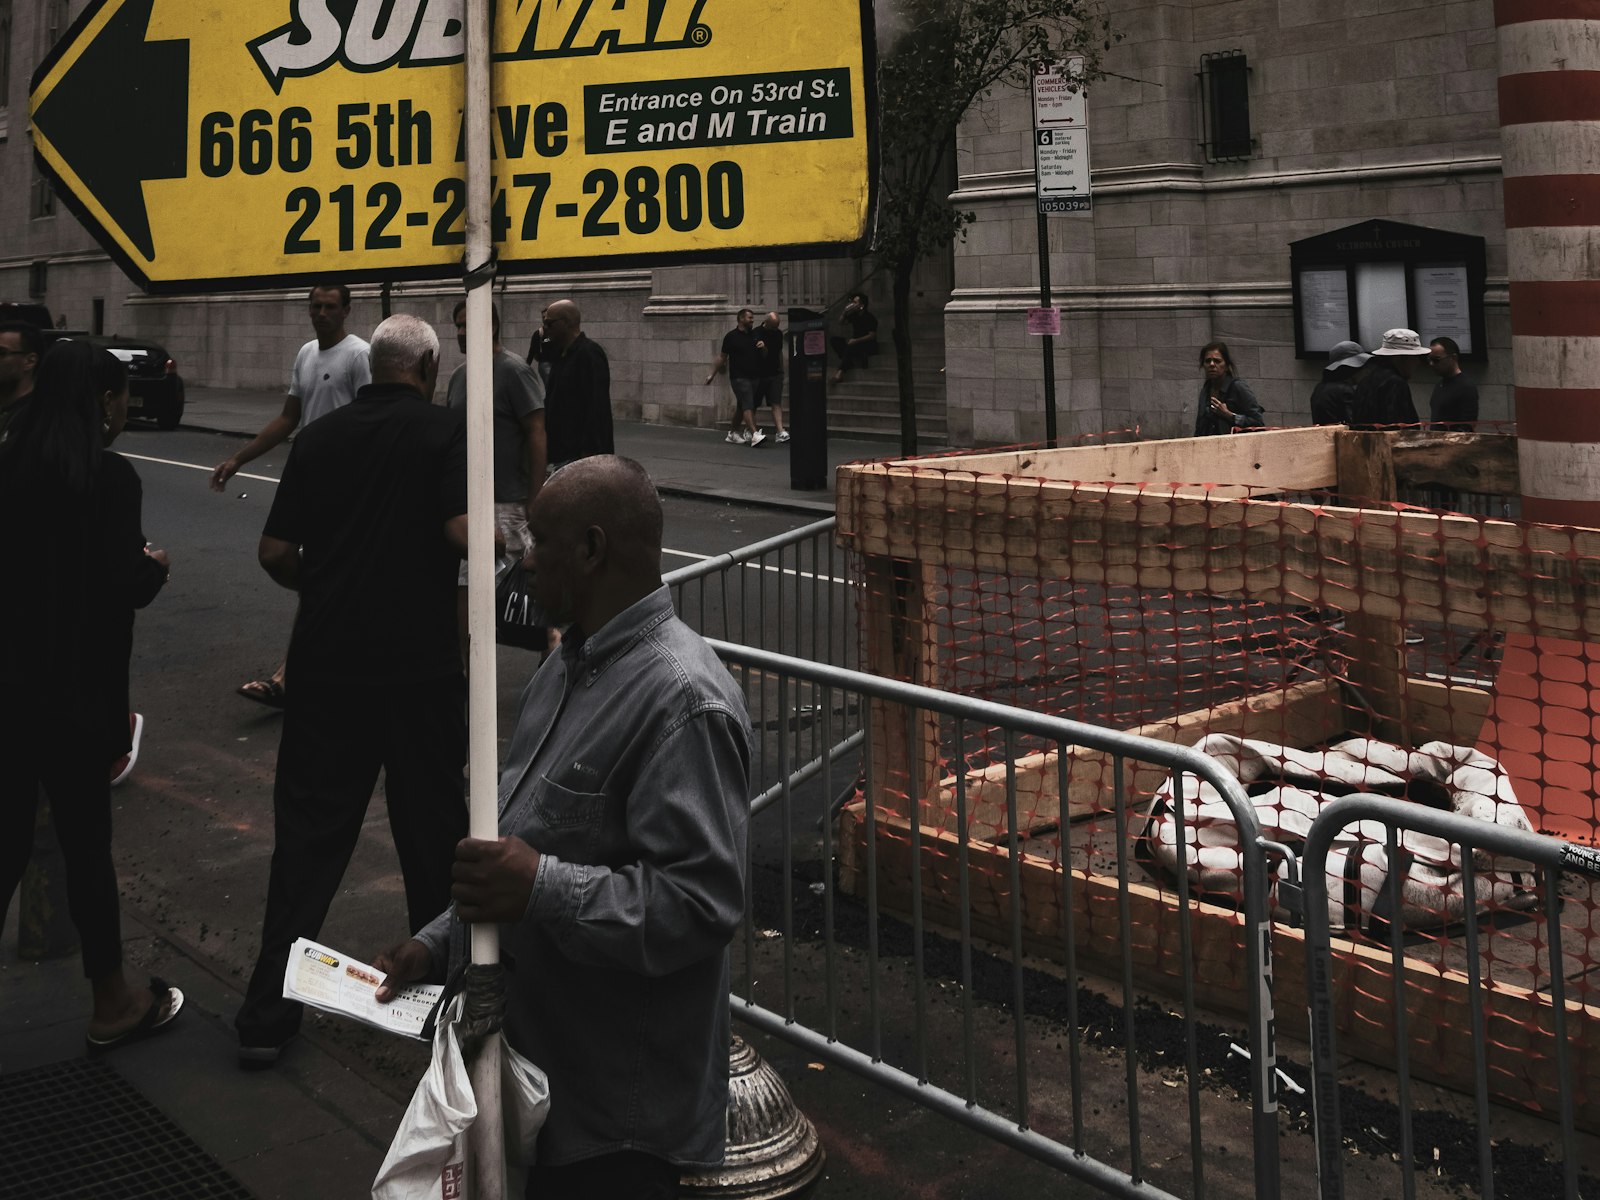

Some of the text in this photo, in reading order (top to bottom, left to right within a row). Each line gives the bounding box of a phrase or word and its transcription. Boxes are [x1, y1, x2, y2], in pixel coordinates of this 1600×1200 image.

[1038, 62, 1046, 74] 3
[1037, 77, 1077, 86] COMMERC
[1037, 85, 1065, 93] VEHICLES
[599, 78, 840, 113] Entrance On 53rd St.
[606, 107, 827, 146] E and M Train
[200, 106, 312, 178] 666
[336, 99, 432, 170] 5th
[1041, 131, 1050, 145] 6
[1042, 201, 1079, 211] 105039
[504, 591, 536, 626] GA
[1564, 852, 1585, 867] AND
[306, 949, 338, 966] SUBWAY
